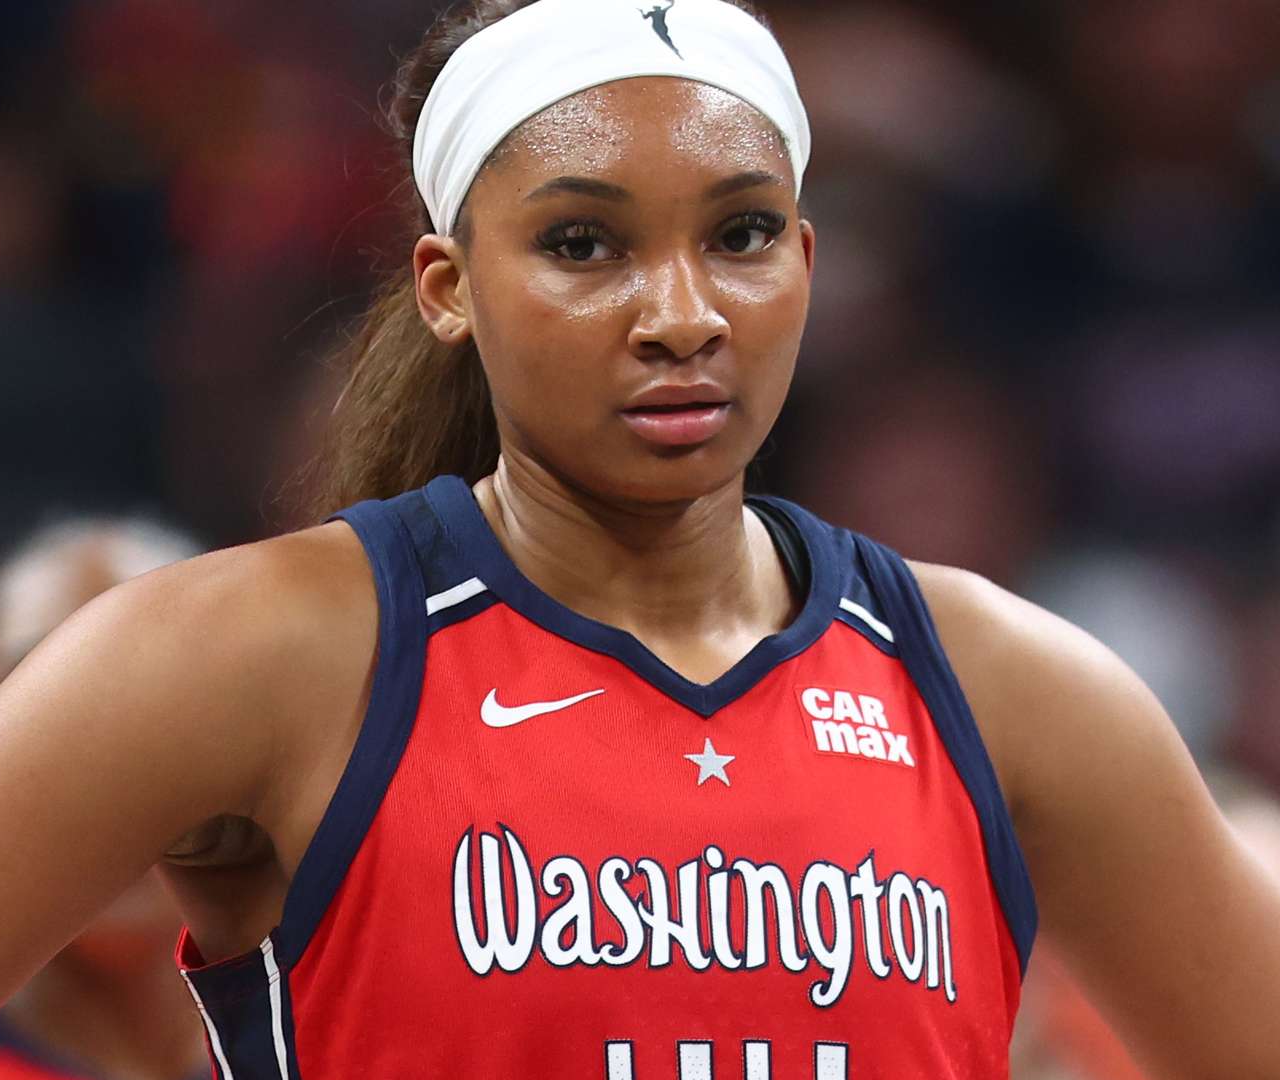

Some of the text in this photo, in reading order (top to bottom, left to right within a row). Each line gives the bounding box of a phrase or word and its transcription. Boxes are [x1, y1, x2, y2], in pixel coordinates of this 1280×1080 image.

[801, 687, 890, 730] CAR
[811, 719, 916, 768] max
[452, 821, 957, 1008] Washington
